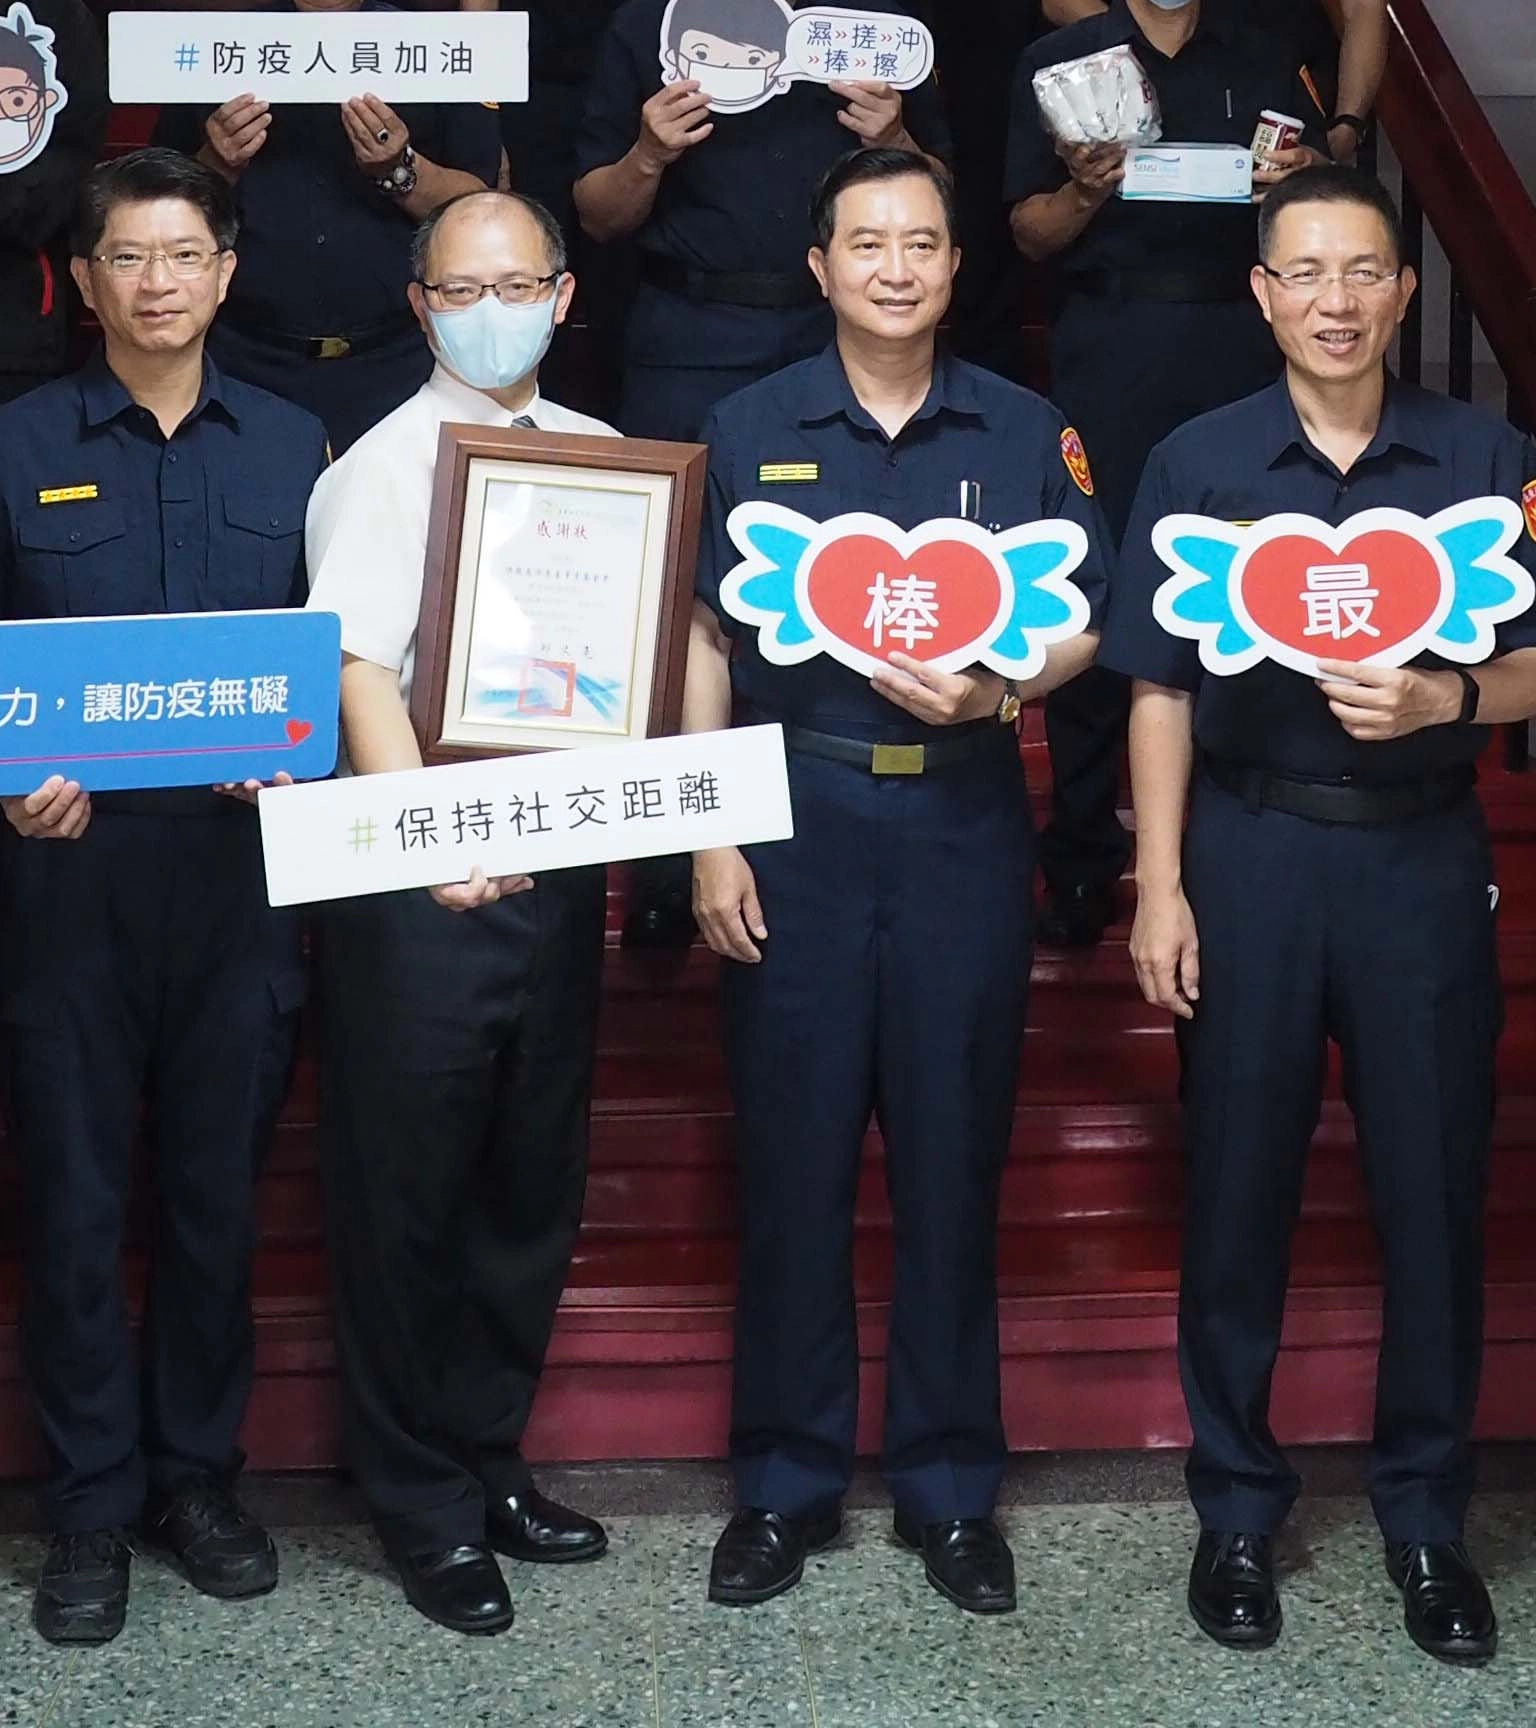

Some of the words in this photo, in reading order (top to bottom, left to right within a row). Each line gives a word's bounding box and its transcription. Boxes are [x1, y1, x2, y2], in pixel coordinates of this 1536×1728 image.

[173, 38, 475, 76] #防疫人員加油
[806, 20, 833, 49] 濕
[852, 23, 877, 52] 搓
[895, 26, 921, 55] 沖
[863, 571, 939, 650] 棒
[1298, 562, 1382, 640] 最
[347, 770, 722, 854] #保持社交距離
